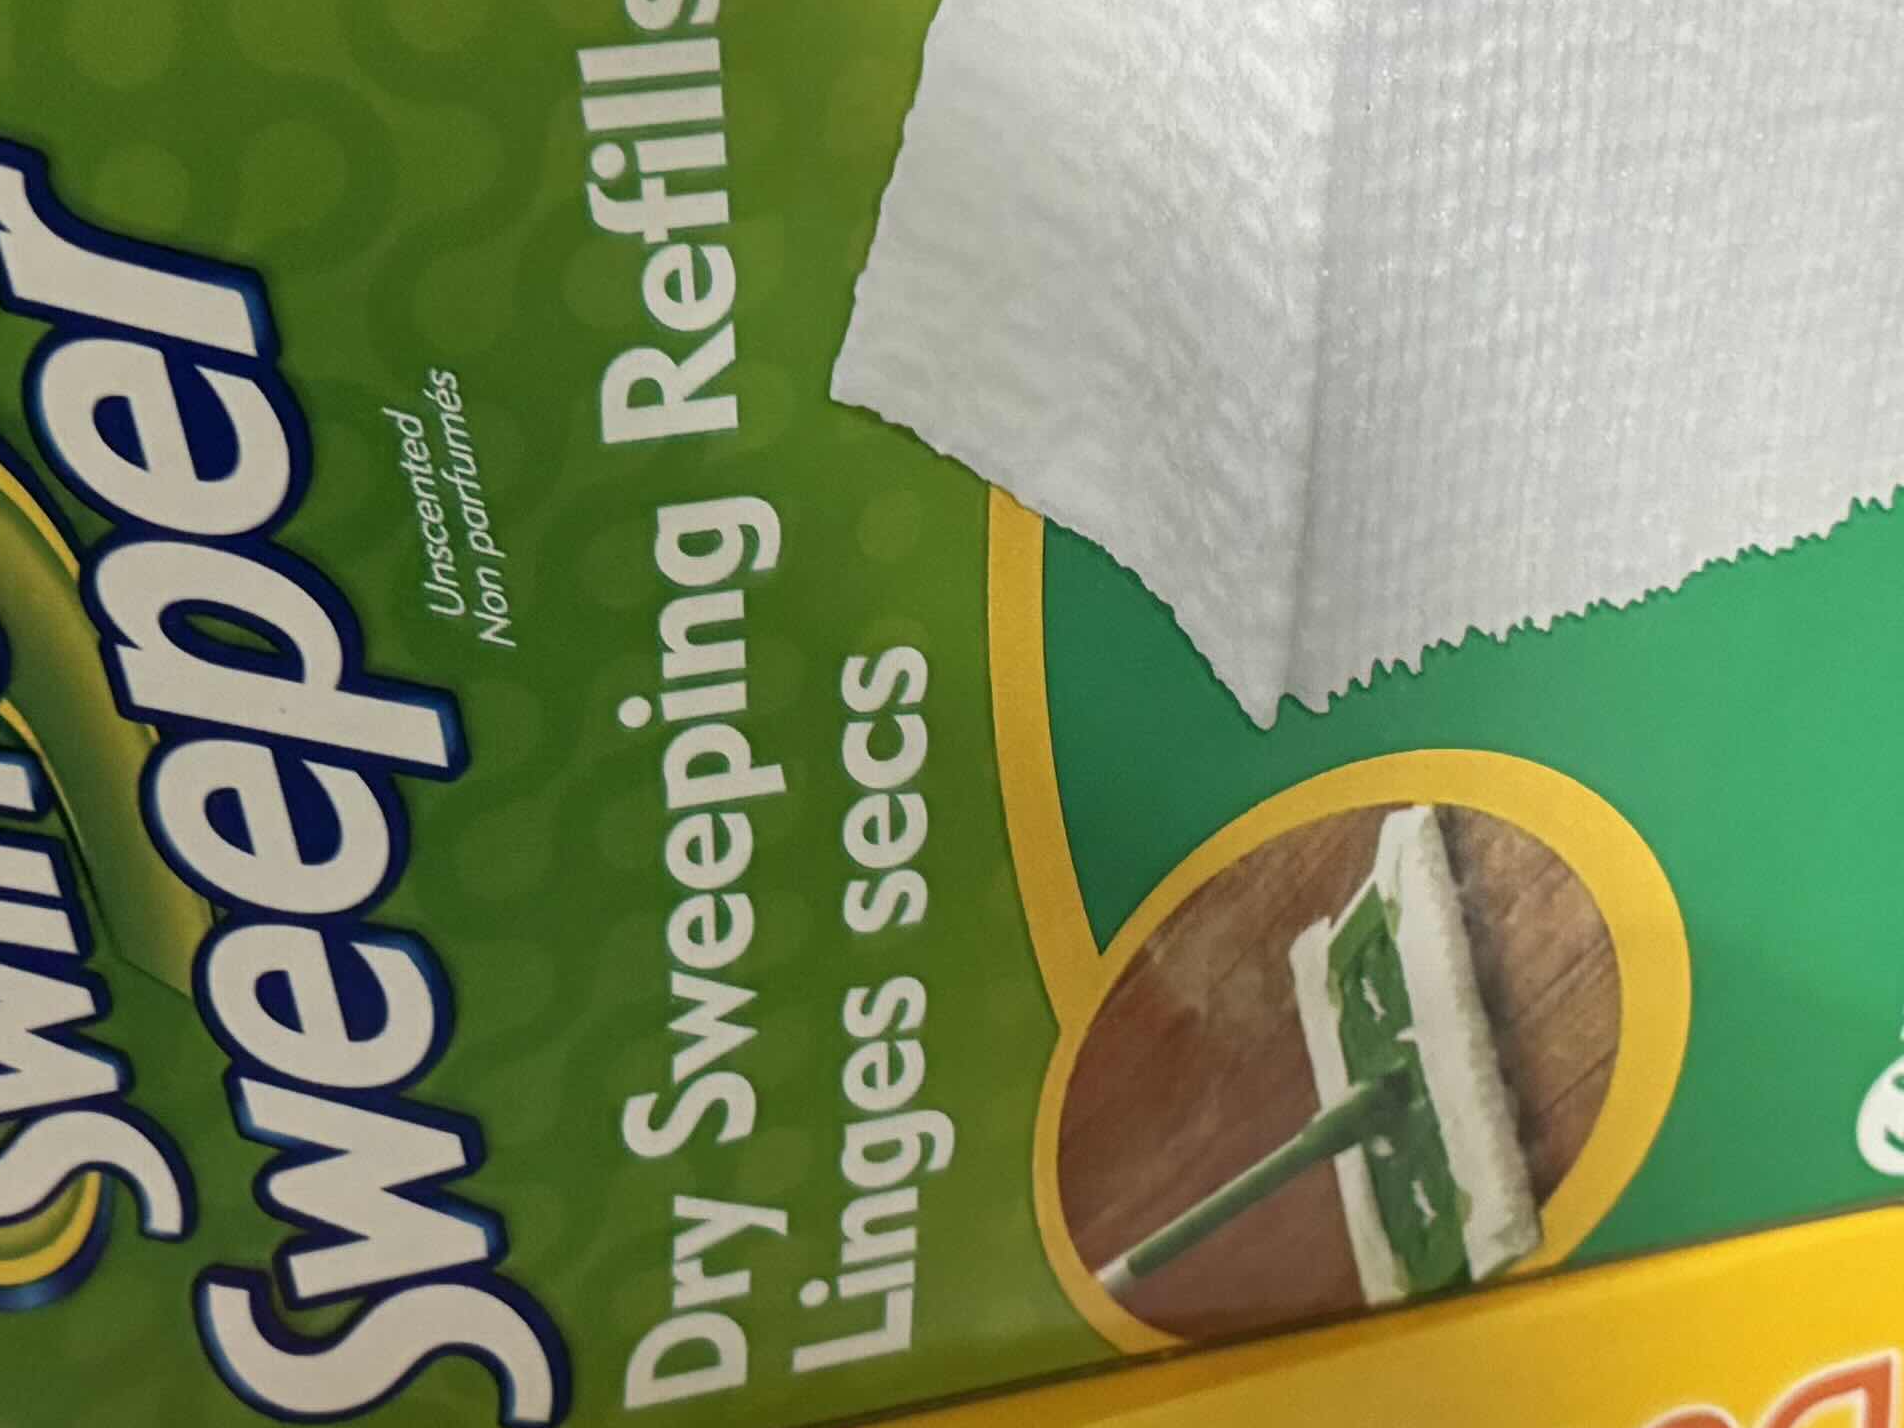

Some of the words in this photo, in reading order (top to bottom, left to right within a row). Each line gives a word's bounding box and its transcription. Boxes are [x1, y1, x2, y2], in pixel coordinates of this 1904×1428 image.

[395, 409, 466, 616] Unscented
[423, 367, 507, 557] parfumés
[474, 566, 516, 647] Non
[622, 496, 788, 1163] Sweeping
[840, 644, 928, 935] secs
[792, 972, 955, 1370] Linges
[626, 1196, 788, 1410] Dry
